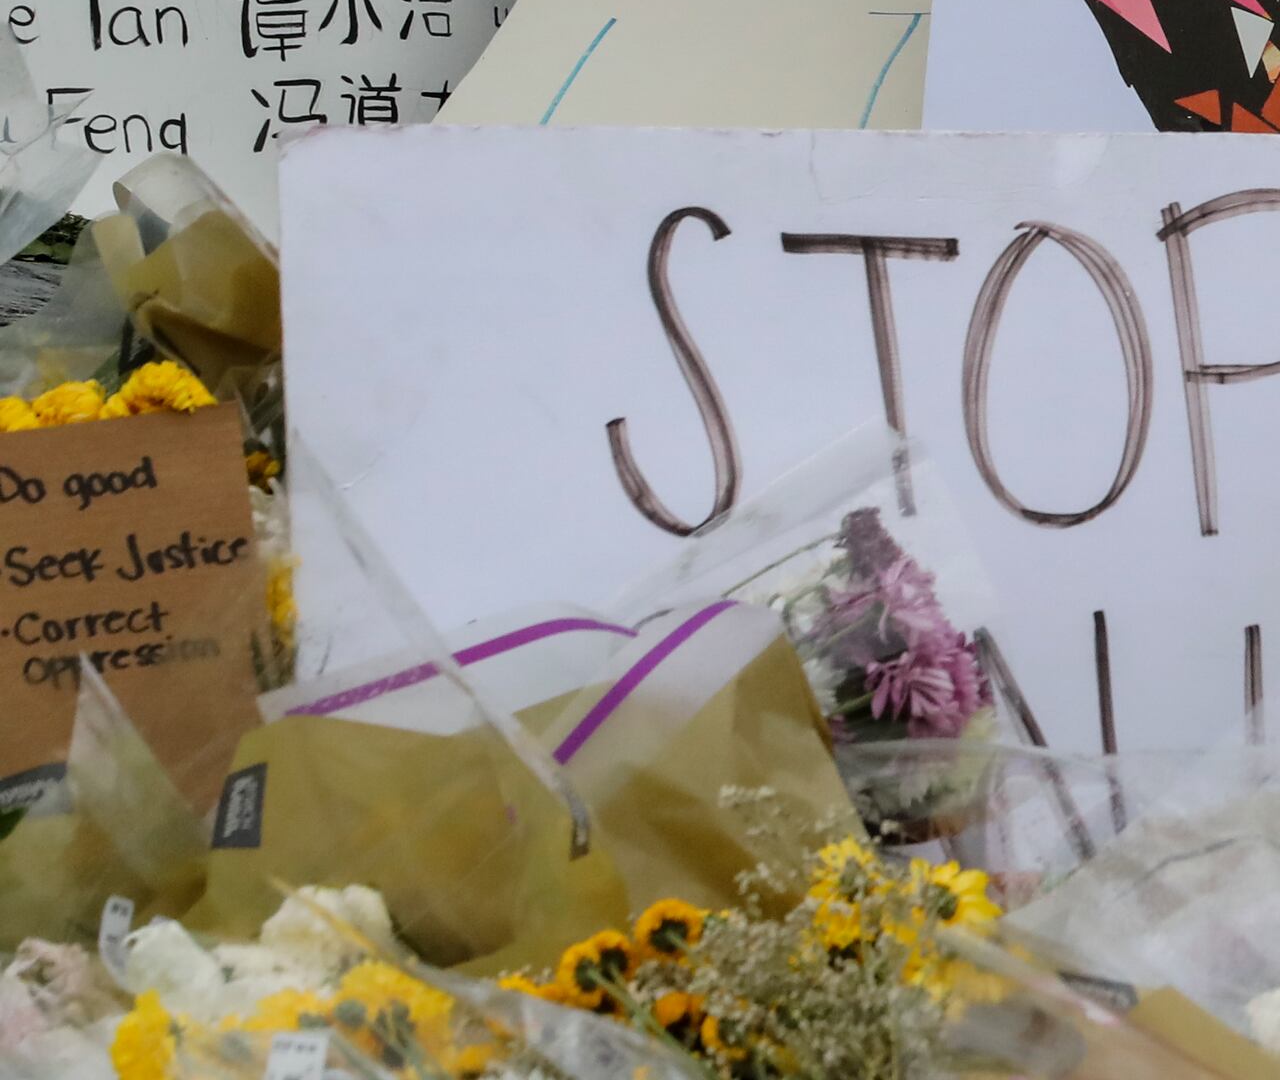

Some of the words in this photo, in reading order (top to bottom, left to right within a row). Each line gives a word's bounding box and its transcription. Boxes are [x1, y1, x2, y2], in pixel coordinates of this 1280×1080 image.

[0, 466, 45, 504] Do
[63, 456, 157, 511] good
[5, 545, 103, 586] Seek
[116, 532, 248, 581] Justice
[15, 601, 168, 645] Correct
